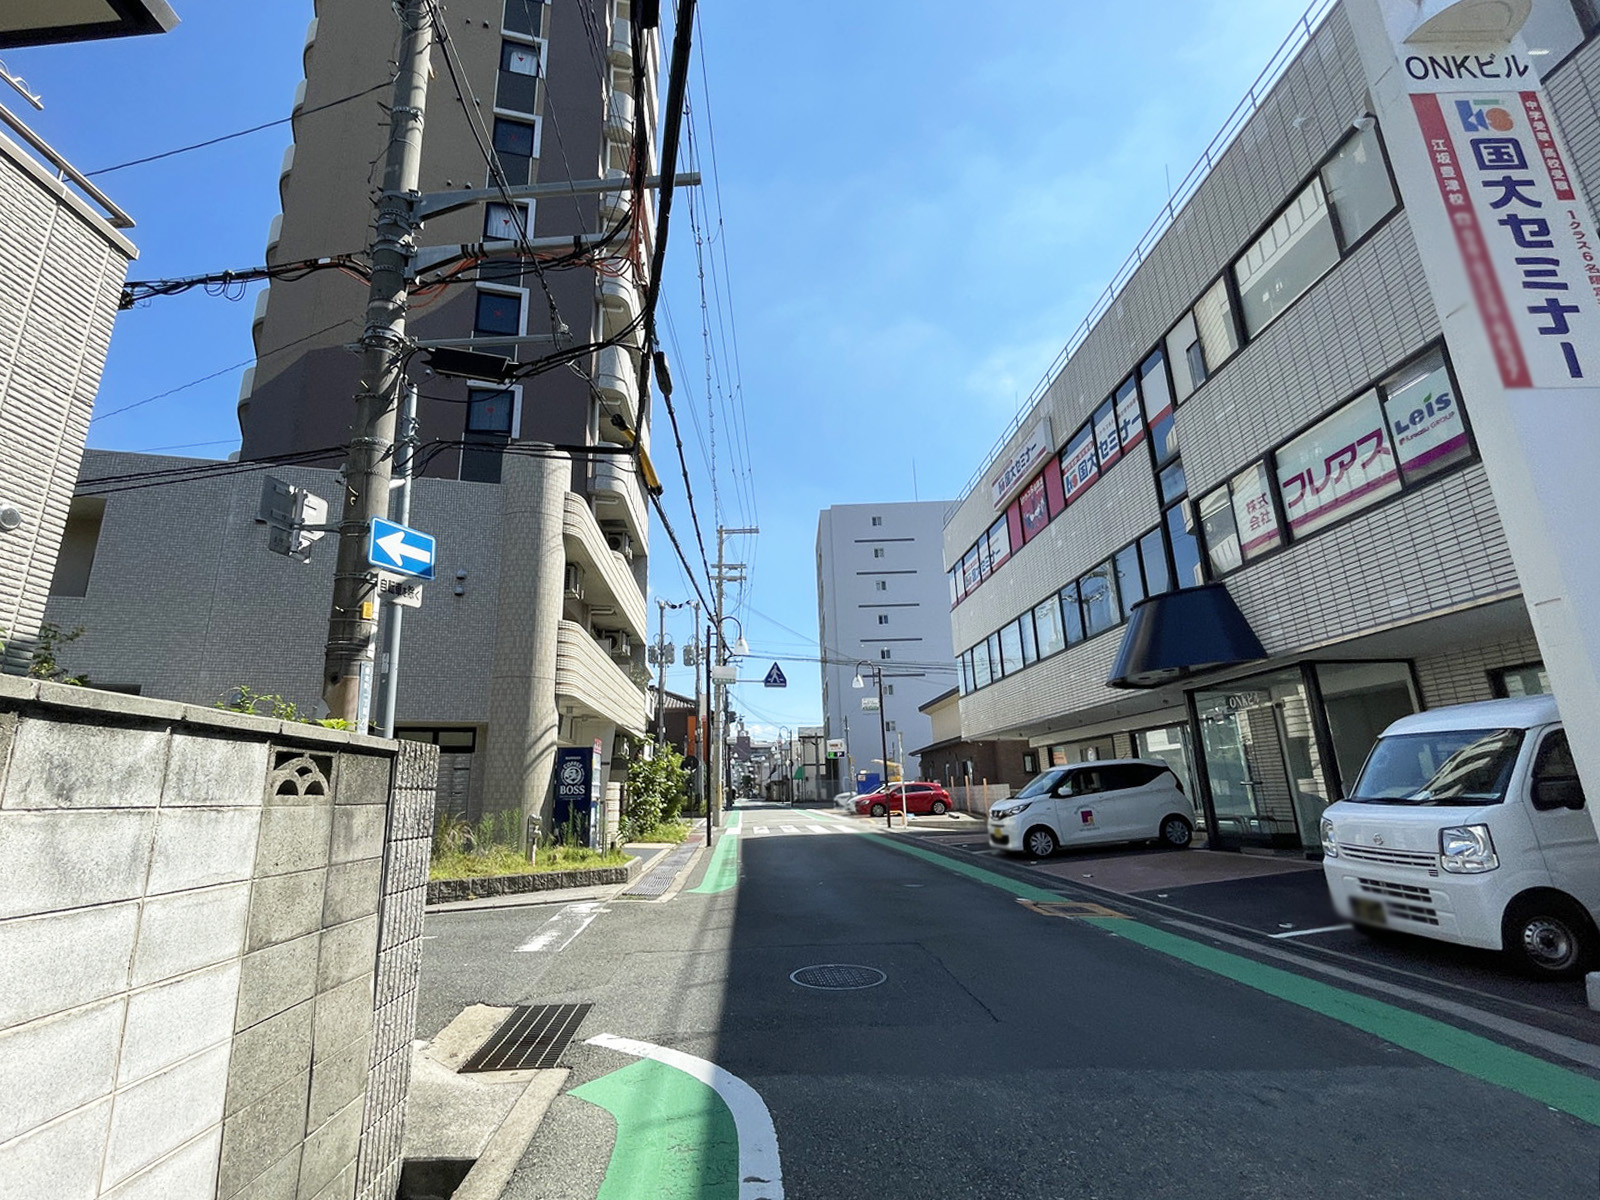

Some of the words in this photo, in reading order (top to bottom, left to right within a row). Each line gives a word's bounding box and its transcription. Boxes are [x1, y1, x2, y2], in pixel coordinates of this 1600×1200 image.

[1405, 53, 1529, 80] ONKビル
[1470, 137, 1584, 379] 国大セミナー
[1394, 392, 1452, 435] Leis
[1282, 427, 1391, 508] フレアス
[560, 785, 585, 795] BOSS
